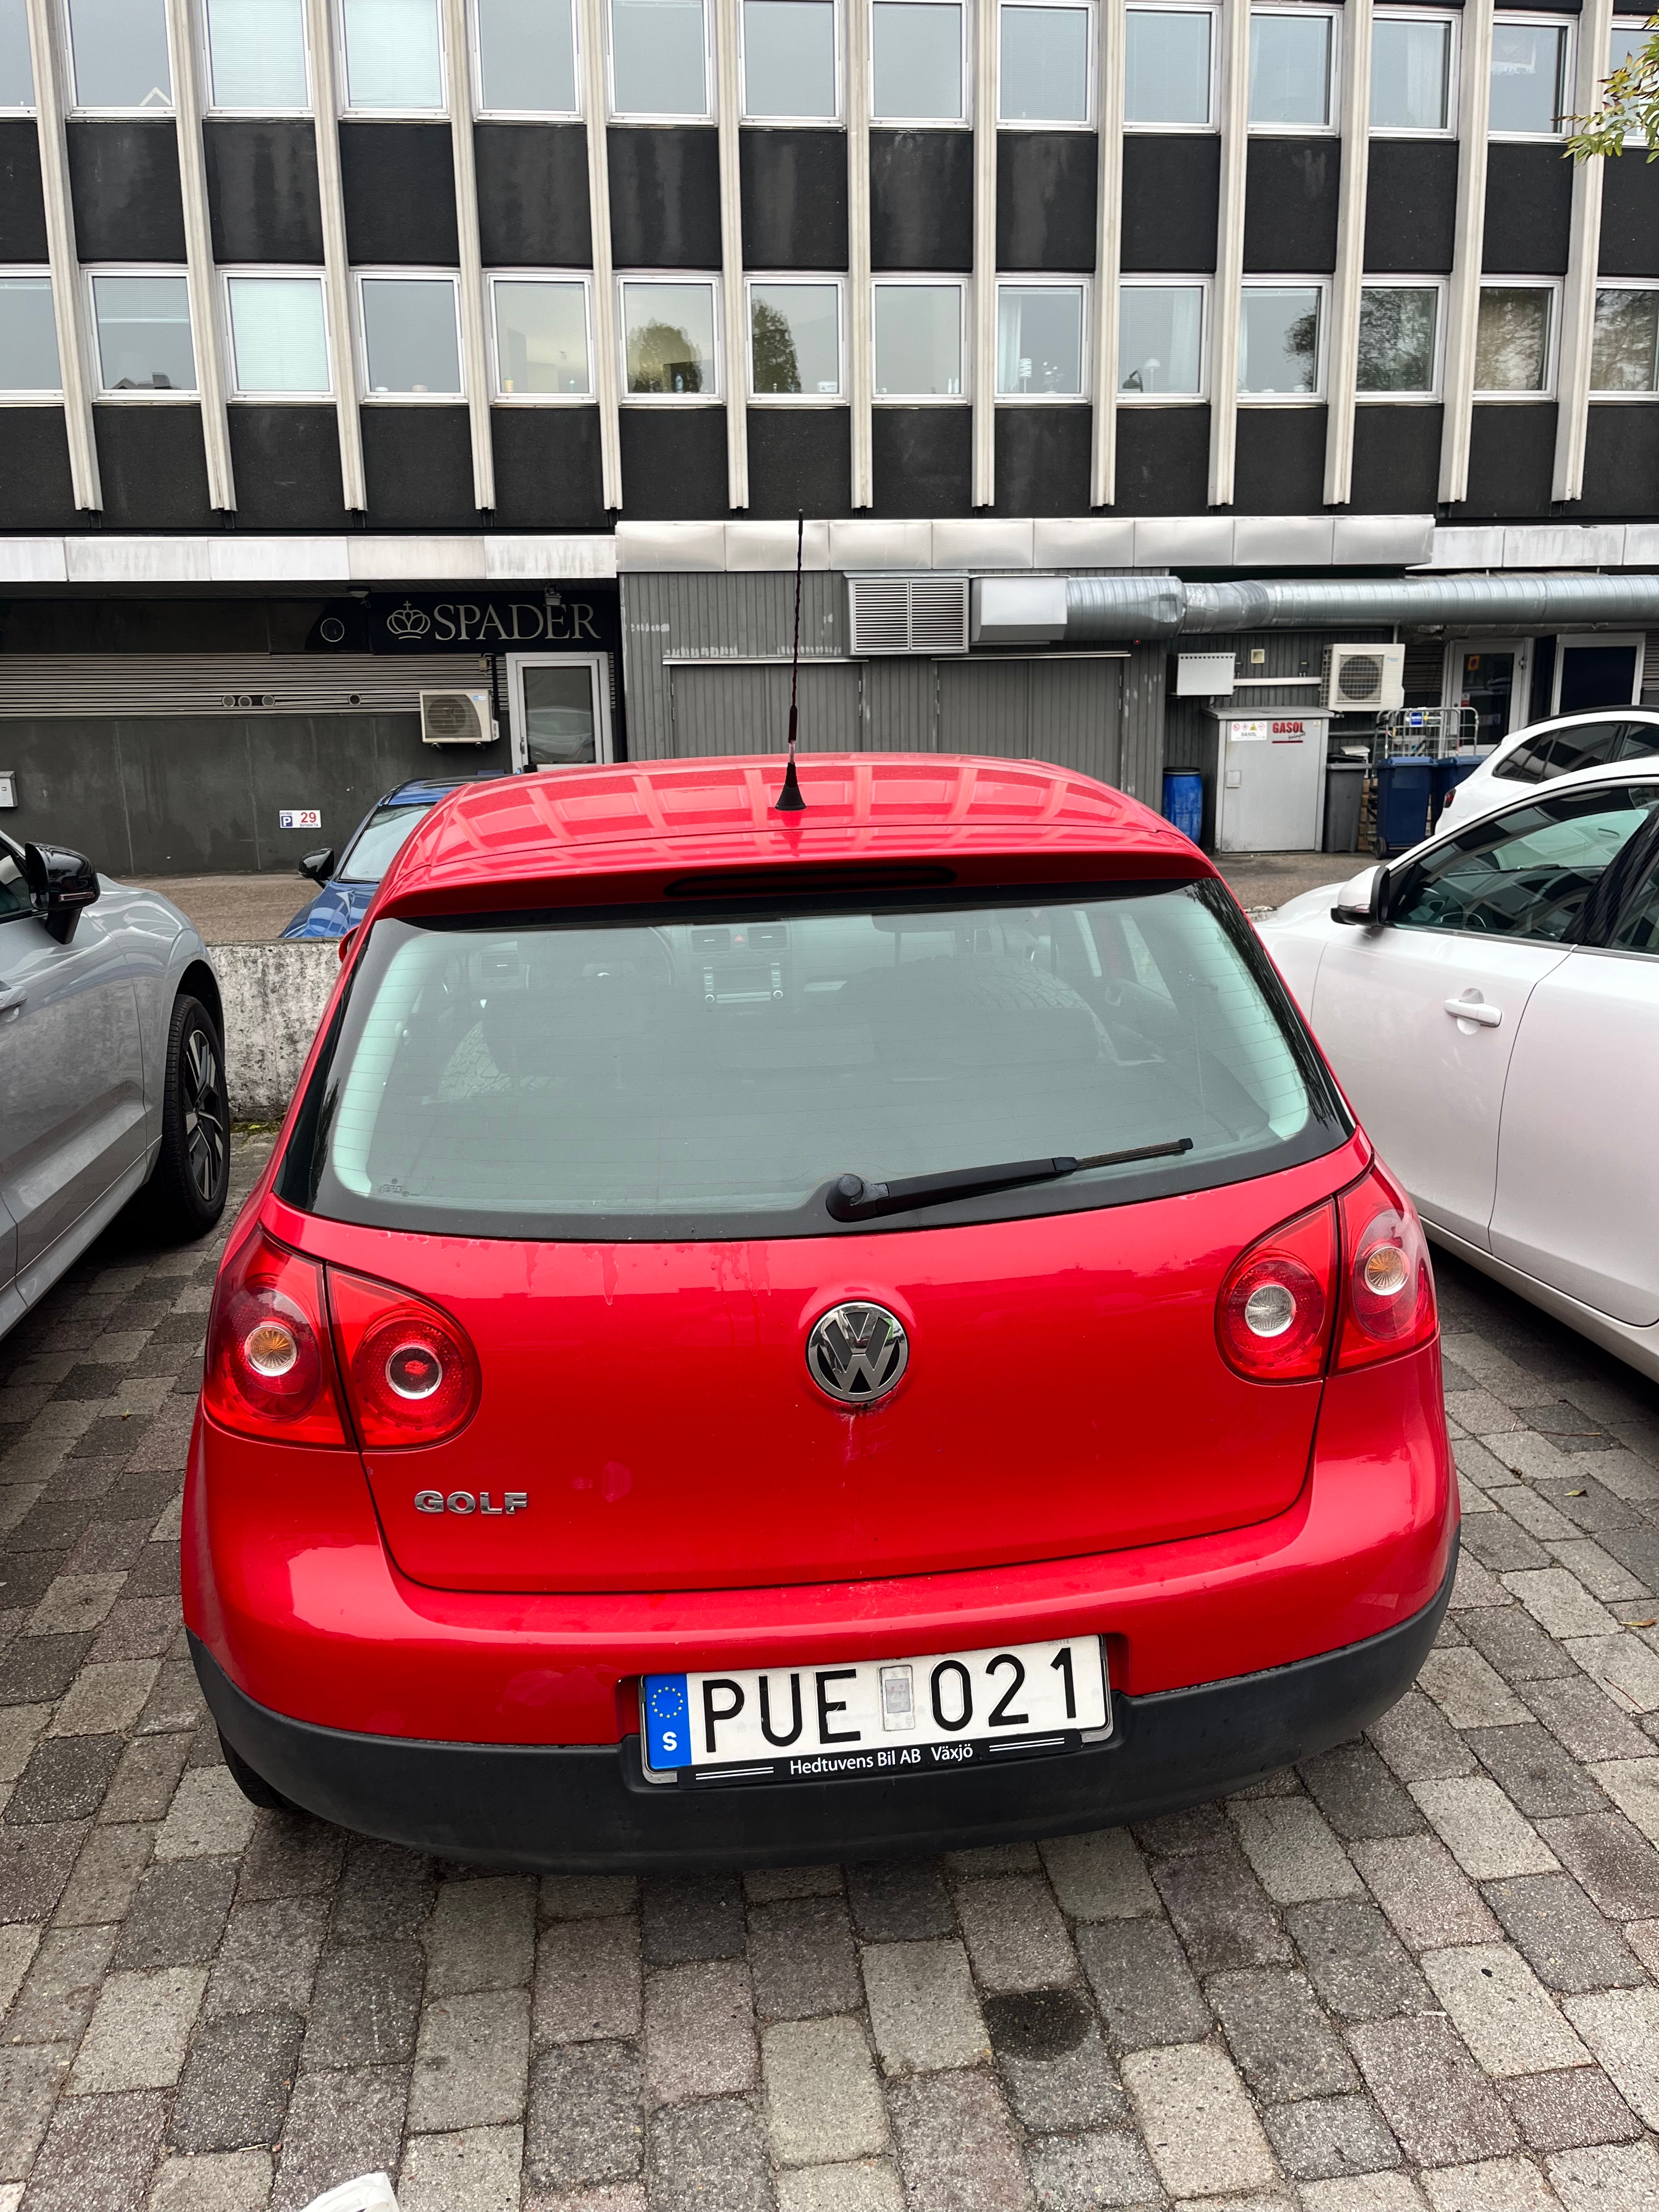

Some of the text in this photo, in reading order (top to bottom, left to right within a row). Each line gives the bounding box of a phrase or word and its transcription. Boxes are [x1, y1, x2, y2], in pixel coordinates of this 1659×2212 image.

[434, 603, 601, 640] SPADER
[1273, 722, 1304, 733] GASOL
[283, 817, 291, 826] P
[301, 812, 316, 822] 29
[414, 1491, 527, 1514] GOLF
[703, 1647, 1076, 1753] PUE 021
[663, 1731, 677, 1751] S
[791, 1743, 973, 1774] Hedtuvens Bil AB Växjö
